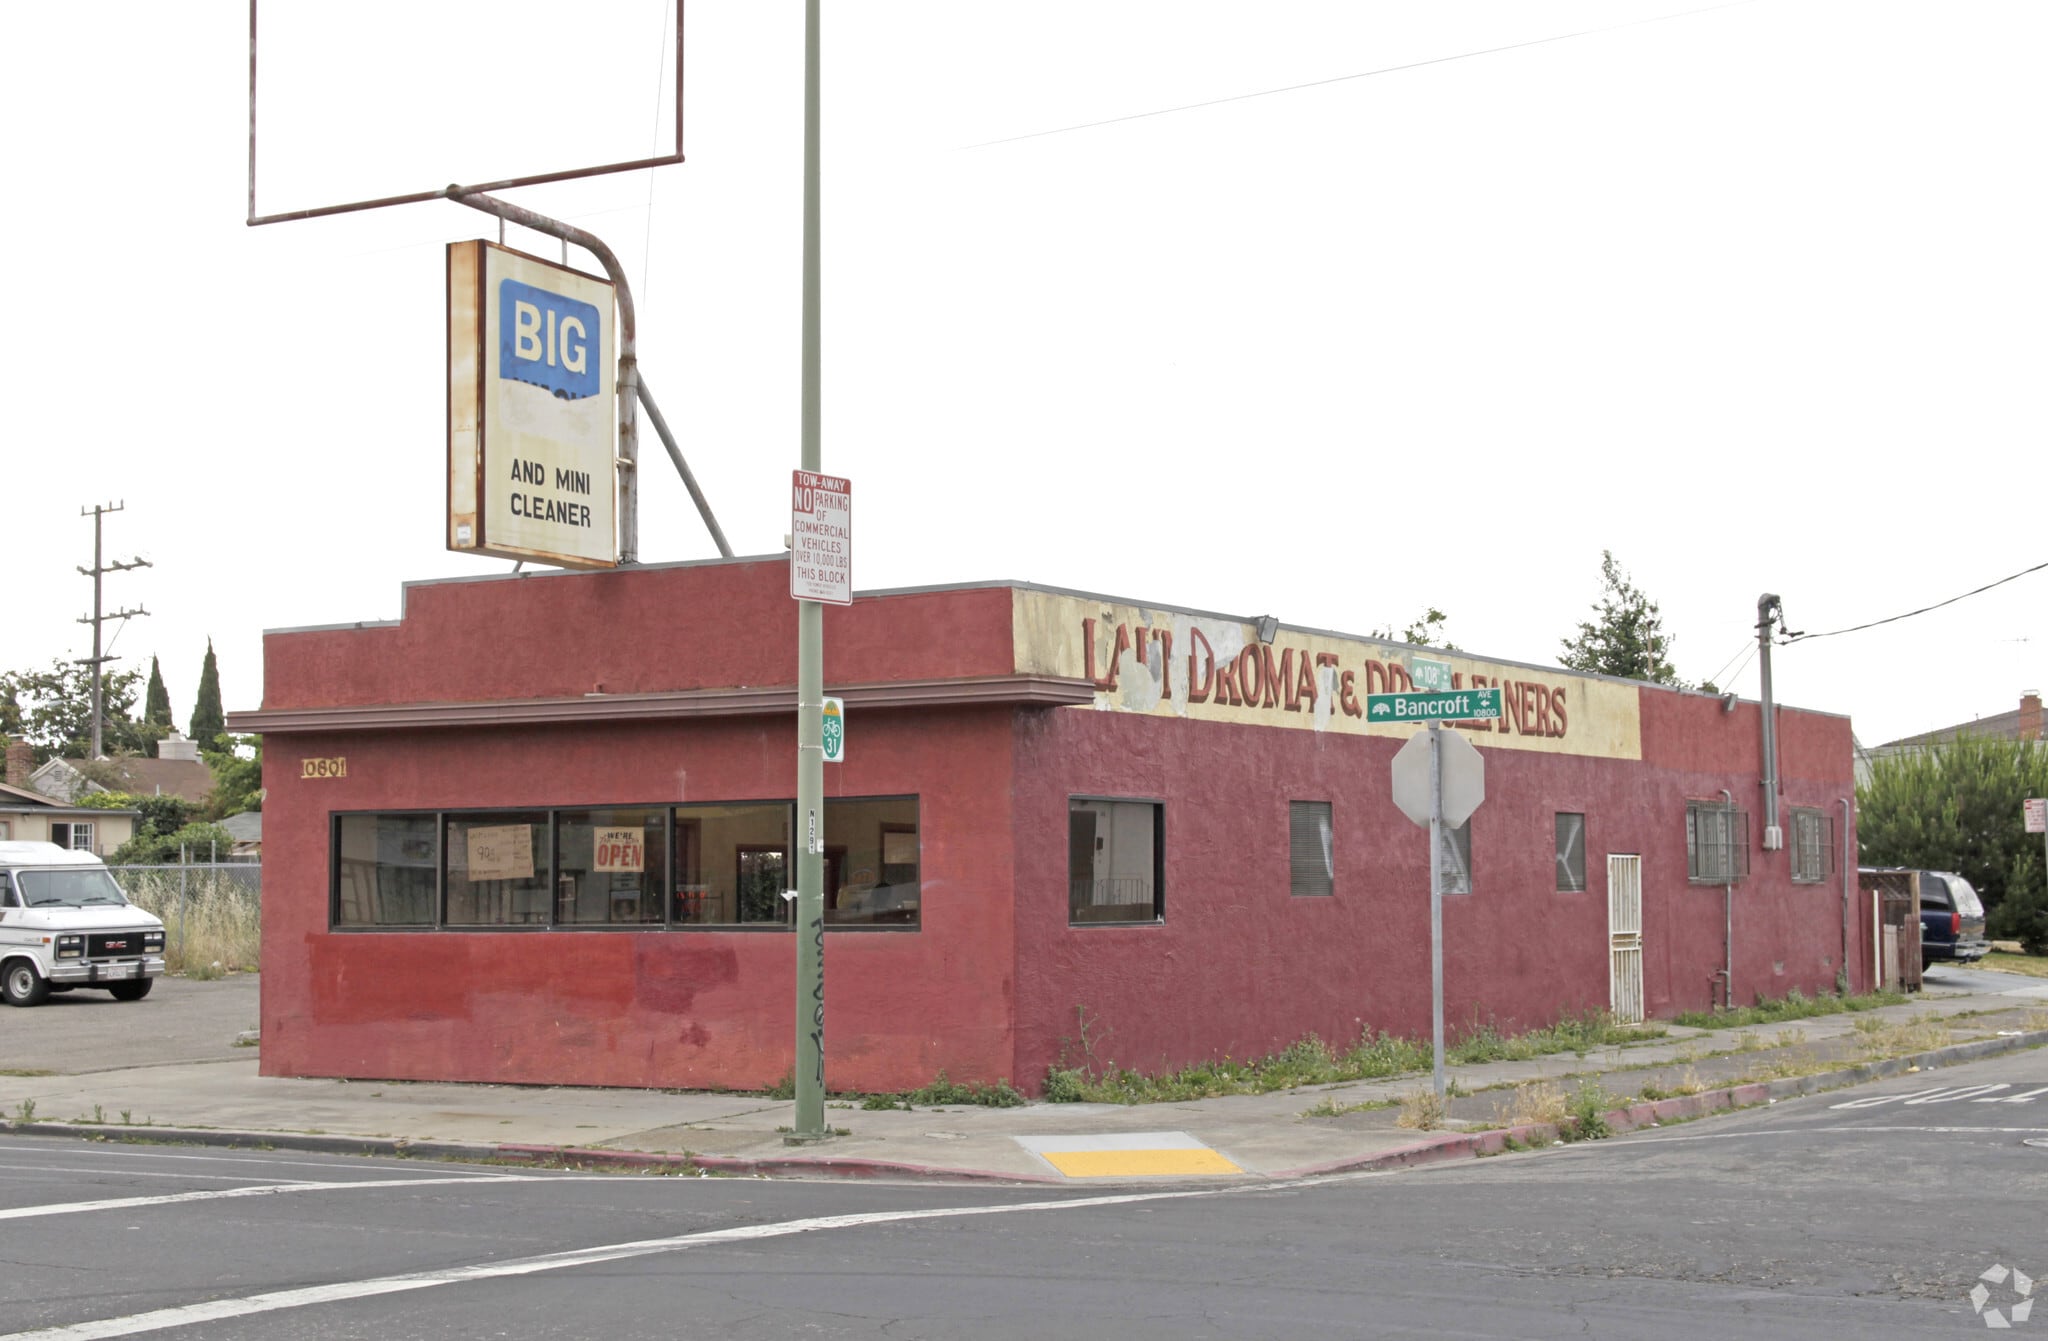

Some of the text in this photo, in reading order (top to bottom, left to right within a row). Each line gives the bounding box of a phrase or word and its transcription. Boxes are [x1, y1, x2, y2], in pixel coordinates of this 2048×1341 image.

[515, 300, 586, 375] BIG
[511, 459, 590, 495] AND MINI
[798, 472, 845, 492] TOW-AWAY
[794, 486, 848, 511] NO PARKING
[511, 493, 591, 528] CLEANER
[816, 510, 827, 521] OF
[795, 520, 848, 539] COMMERCIAL
[801, 537, 841, 553] VEHICLES
[795, 550, 811, 562] OVER
[835, 557, 847, 568] LBS
[797, 566, 845, 584] THIS BLOCK
[1341, 671, 1363, 719] &
[1395, 690, 1492, 717] Bancroft AVE
[1473, 708, 1497, 717] 10800
[827, 738, 837, 753] 31
[598, 845, 642, 866] OPEN
